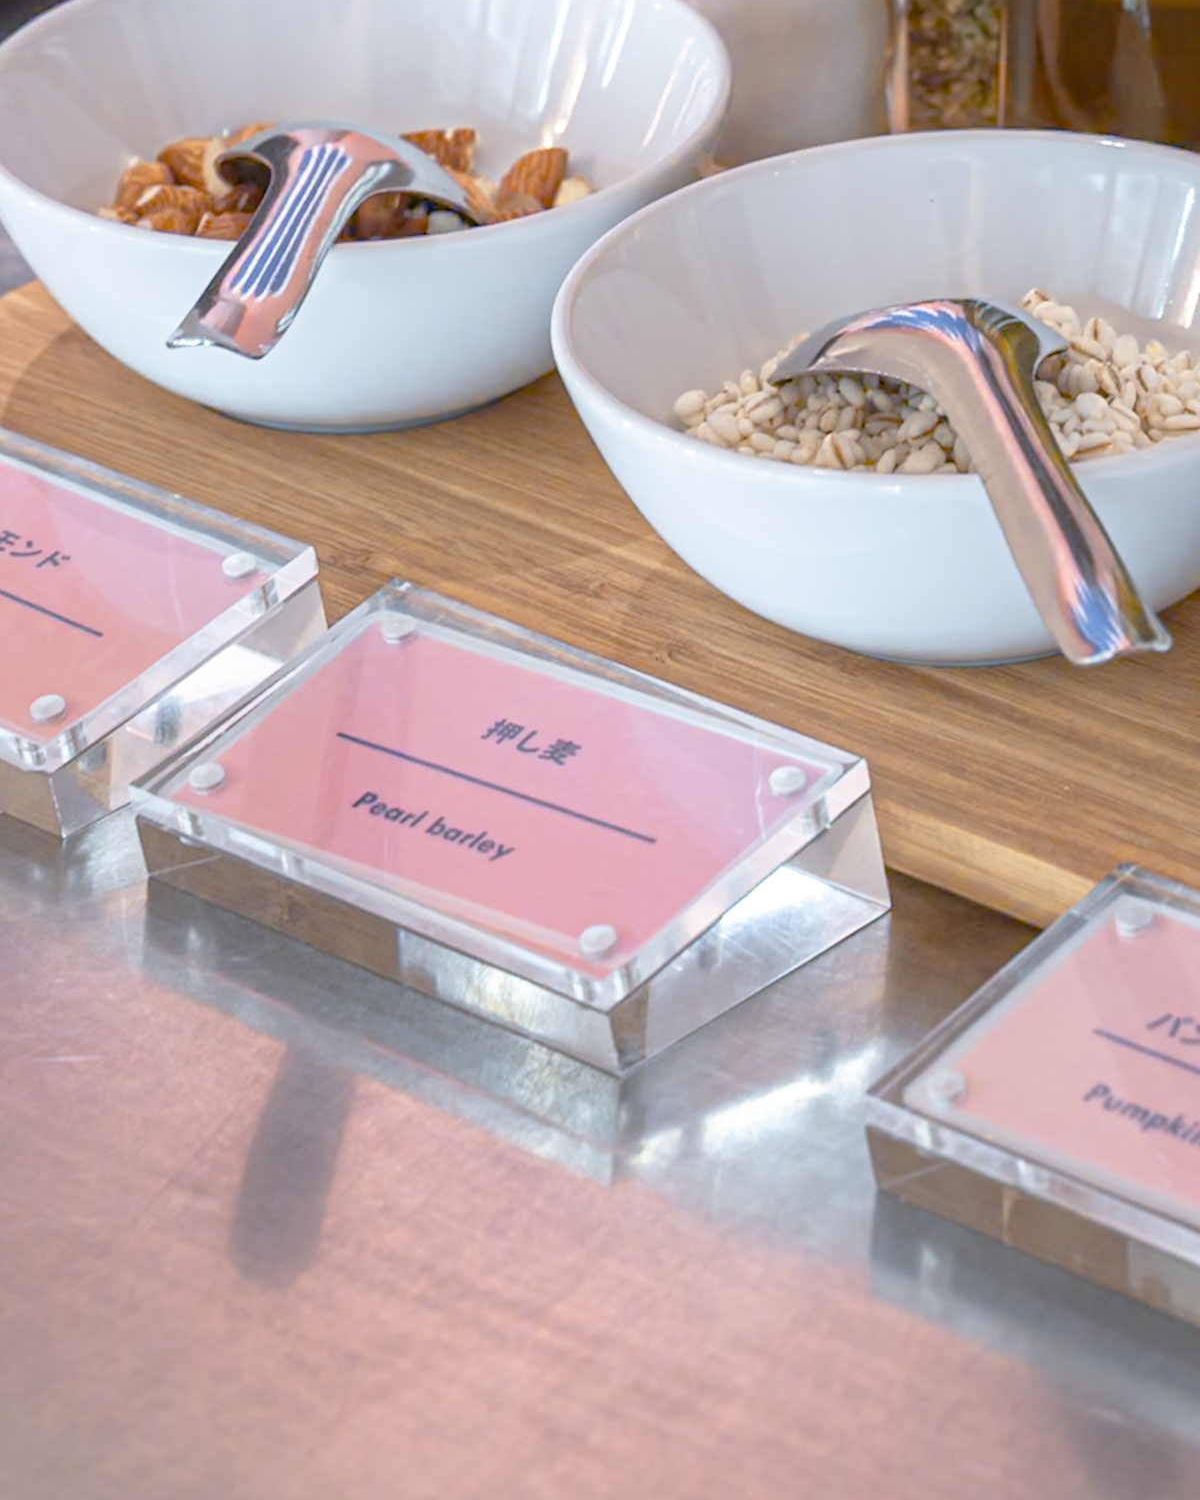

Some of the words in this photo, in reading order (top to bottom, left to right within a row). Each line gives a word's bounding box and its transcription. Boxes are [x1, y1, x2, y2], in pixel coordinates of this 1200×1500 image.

[480, 718, 582, 767] 押し麦
[351, 791, 430, 829] Pearl
[425, 816, 516, 863] barley
